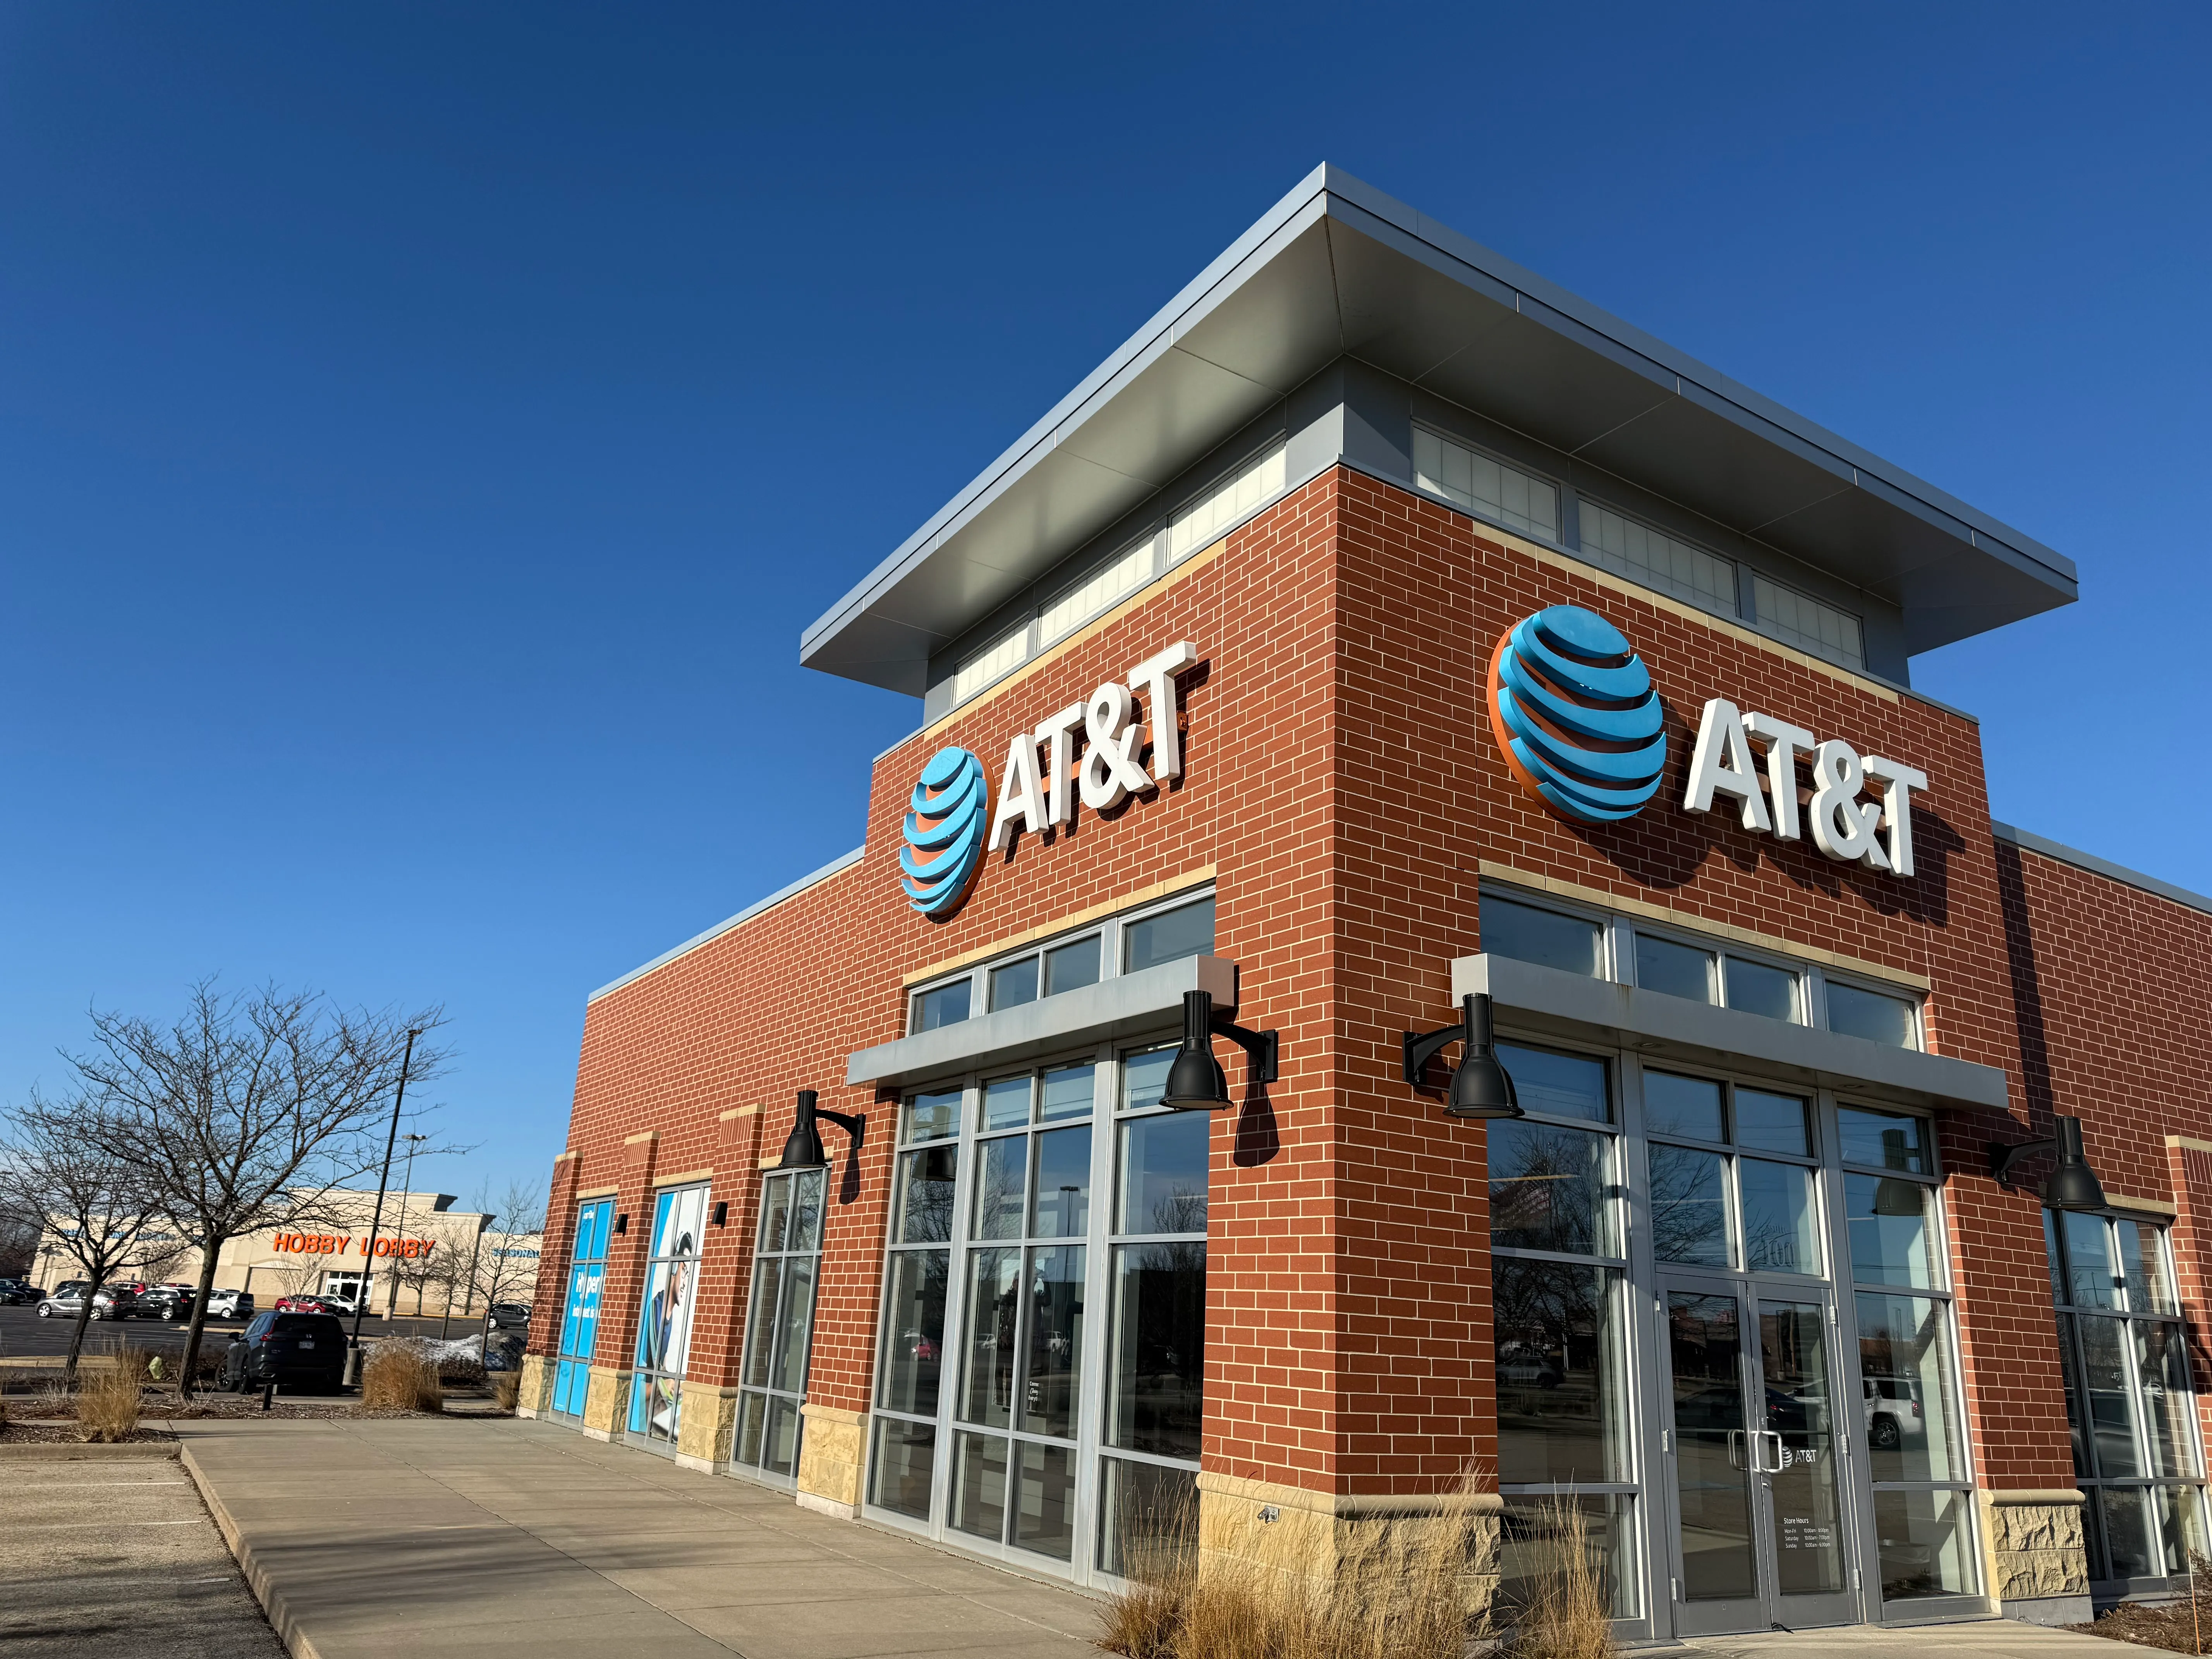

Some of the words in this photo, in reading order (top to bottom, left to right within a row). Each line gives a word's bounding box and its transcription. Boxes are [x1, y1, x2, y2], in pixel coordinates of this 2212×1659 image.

[988, 640, 1196, 852] AT&T
[1683, 697, 1929, 878] AT&T
[273, 1233, 351, 1254] HOBBY
[359, 1237, 436, 1258] LOBBY
[1795, 1449, 1817, 1463] AT&T
